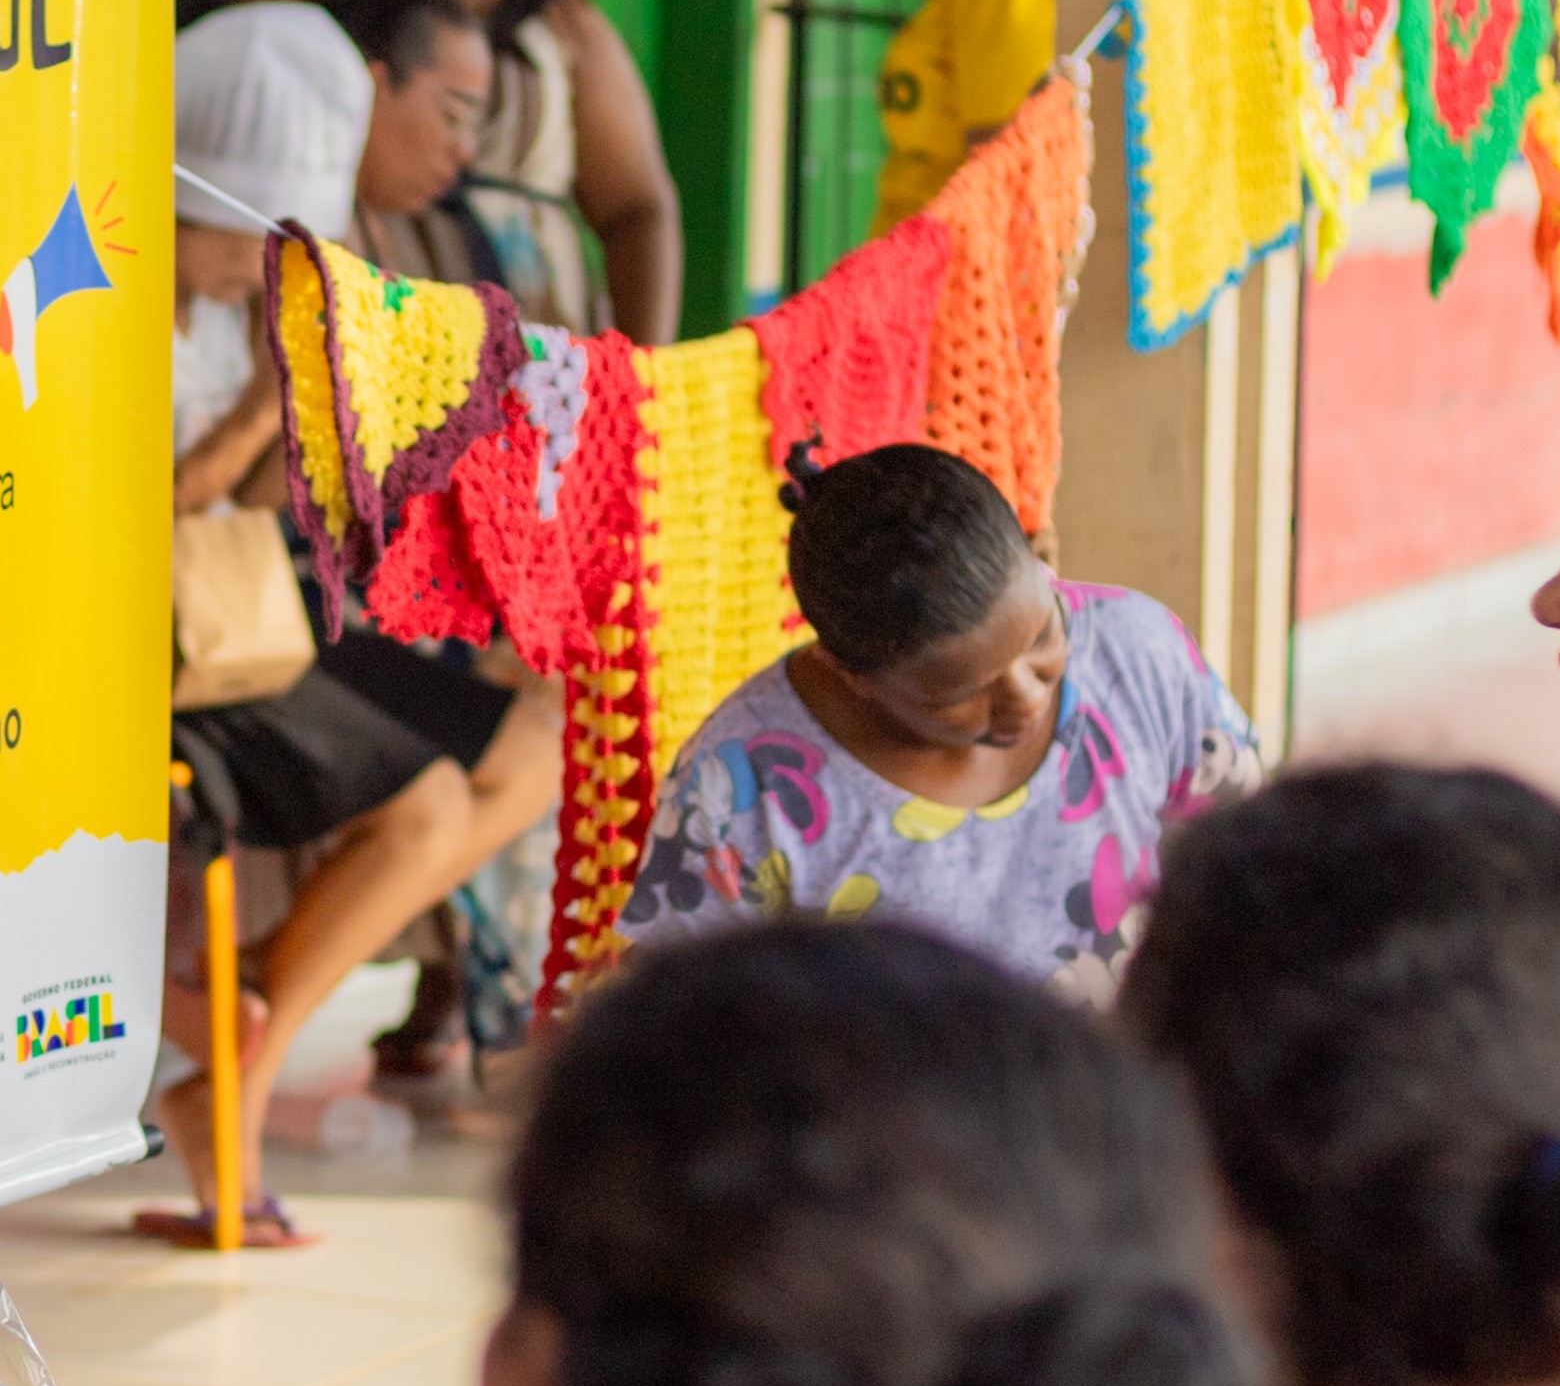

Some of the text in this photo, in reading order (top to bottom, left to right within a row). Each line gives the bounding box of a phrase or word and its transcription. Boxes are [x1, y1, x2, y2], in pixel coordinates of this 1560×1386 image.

[22, 974, 112, 1004] GOVERNO FEDERAL
[16, 992, 125, 1064] BRASIL
